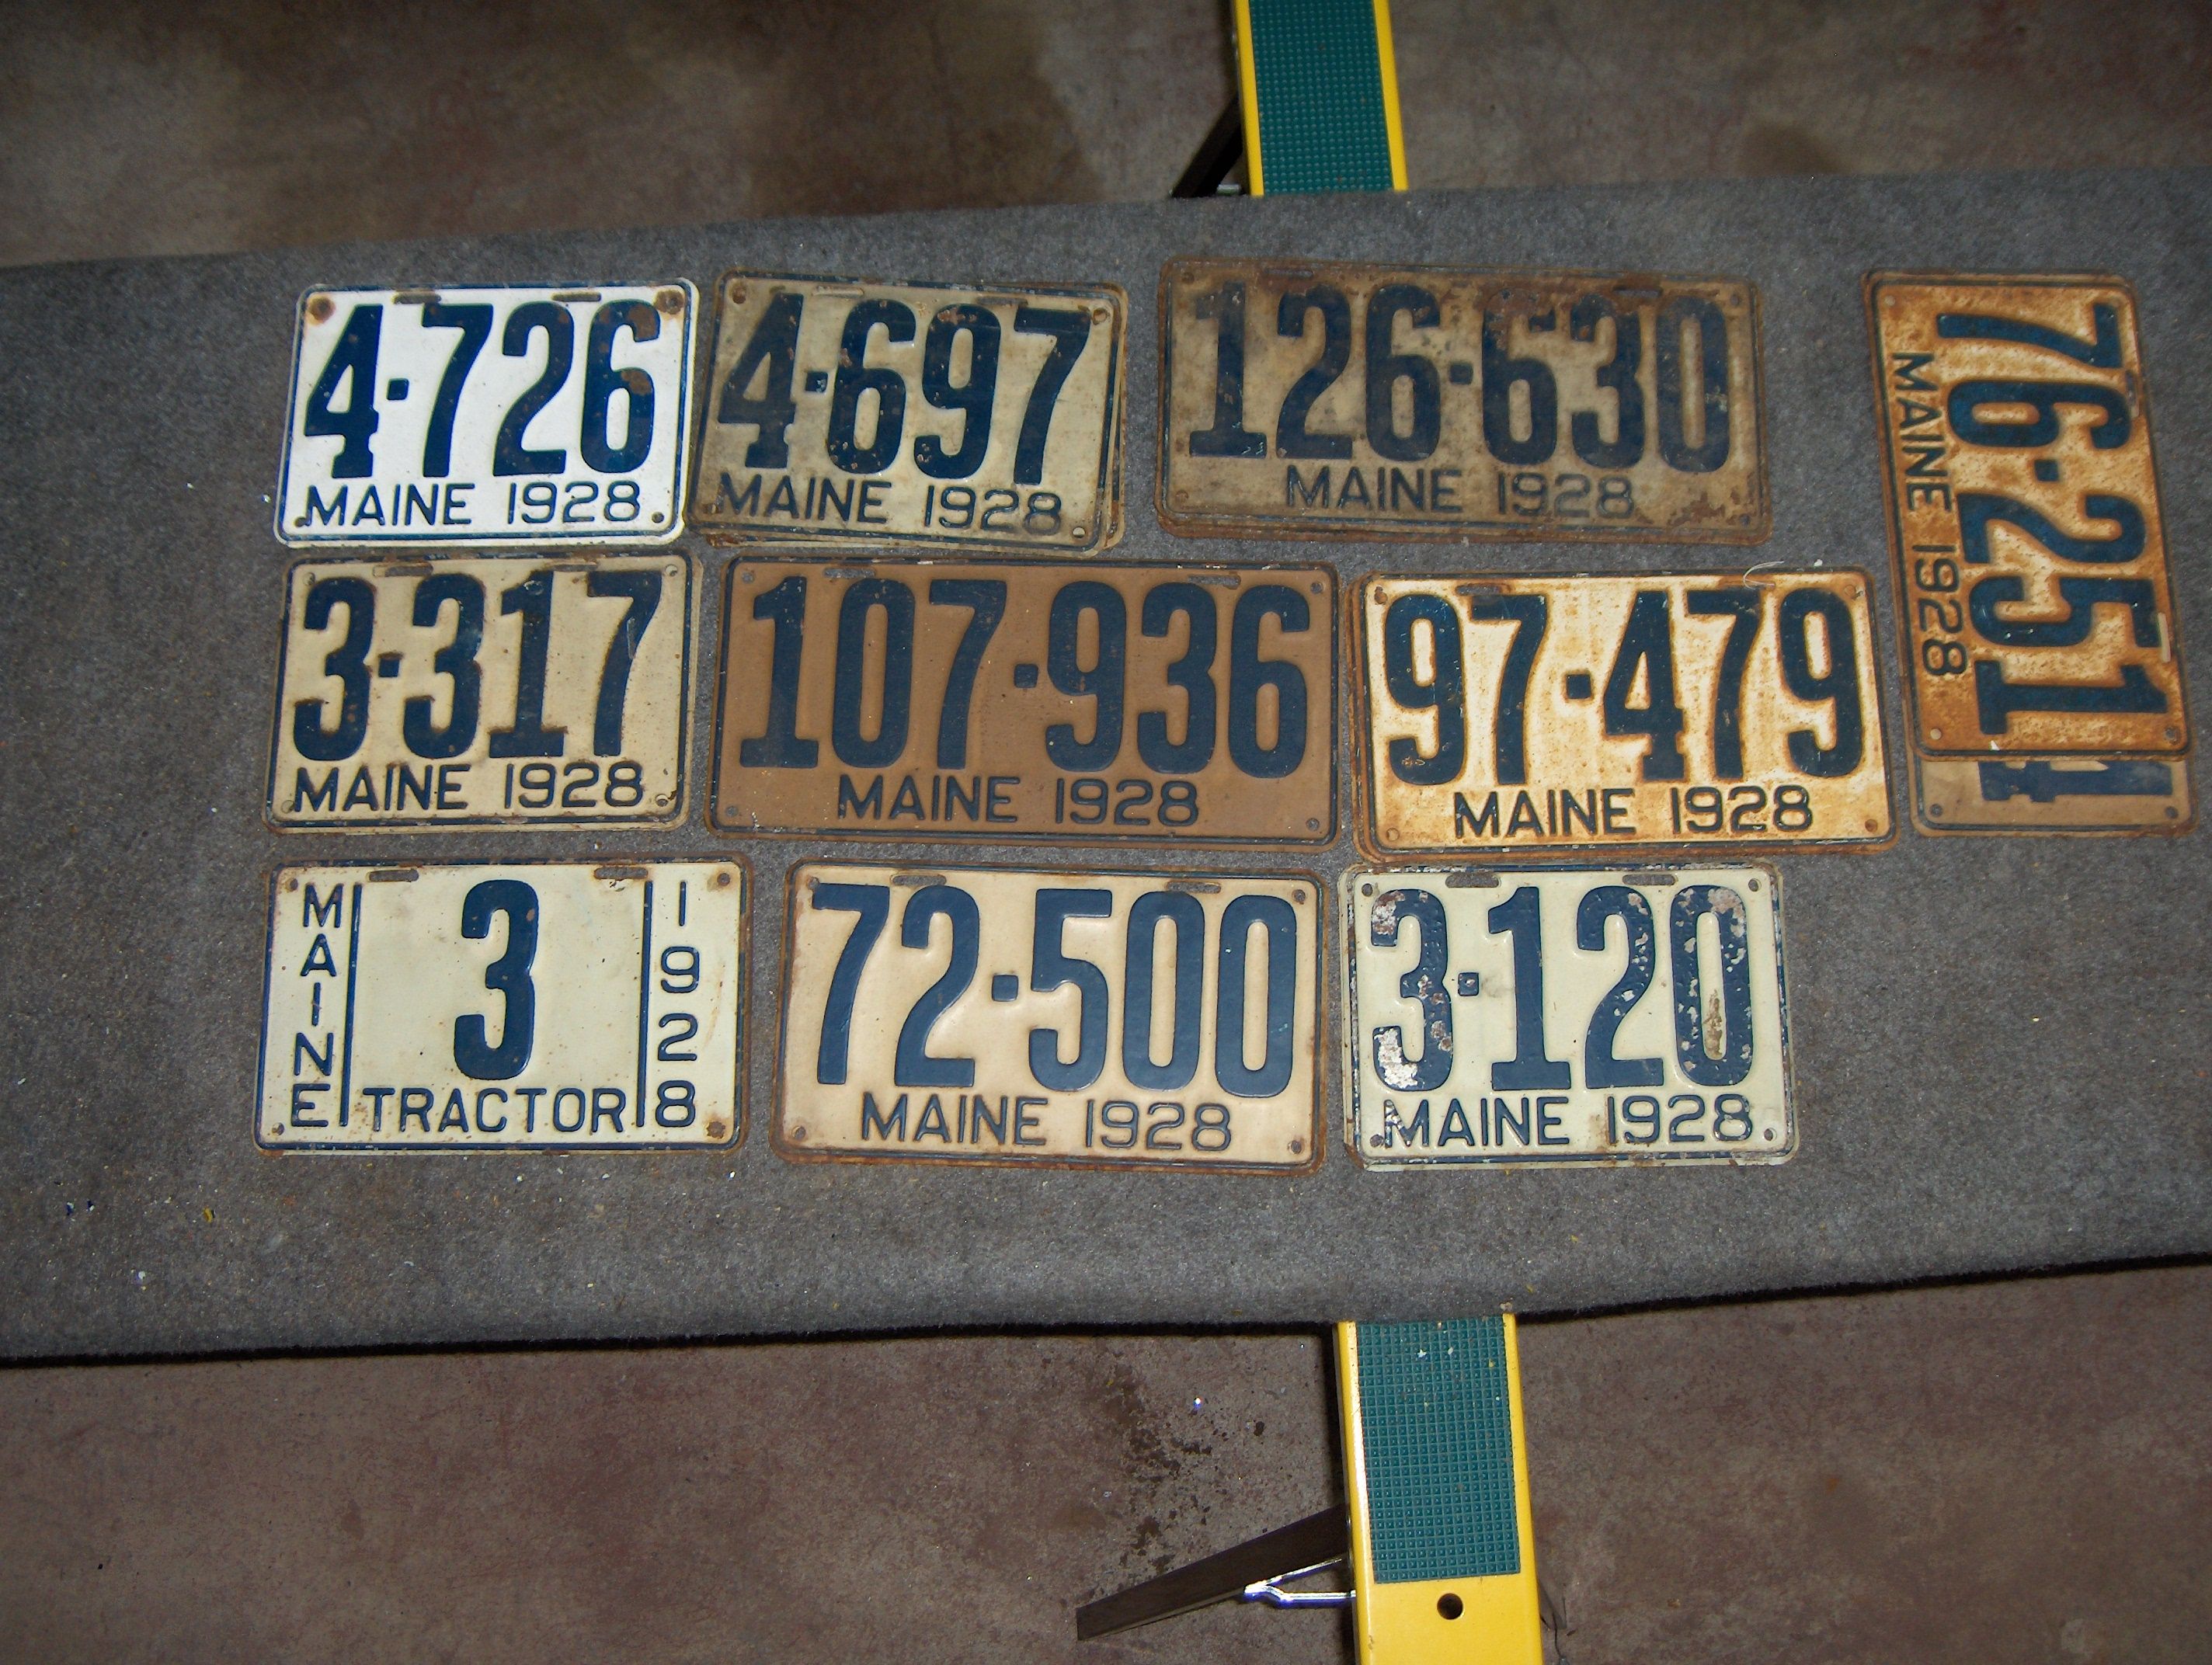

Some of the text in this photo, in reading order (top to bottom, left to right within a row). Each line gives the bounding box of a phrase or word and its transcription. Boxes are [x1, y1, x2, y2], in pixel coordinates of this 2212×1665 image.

[304, 481, 641, 526] MAINE 1928
[717, 472, 1063, 536] MAINE 1928
[1286, 465, 1636, 519] MAINE 1928
[1892, 352, 1969, 678] MAINE 1928
[294, 761, 644, 812] MAINE 1928
[838, 773, 1199, 827] MAINE 1928
[1453, 785, 1814, 839] MAINE 1928
[290, 883, 343, 1128] MAINE
[454, 879, 539, 1080] 3
[655, 881, 700, 1128] 1928
[363, 1087, 627, 1133] TRACTOR
[861, 1093, 1232, 1152] MAINE 1928
[1383, 1093, 1754, 1149] MAINE 1928
